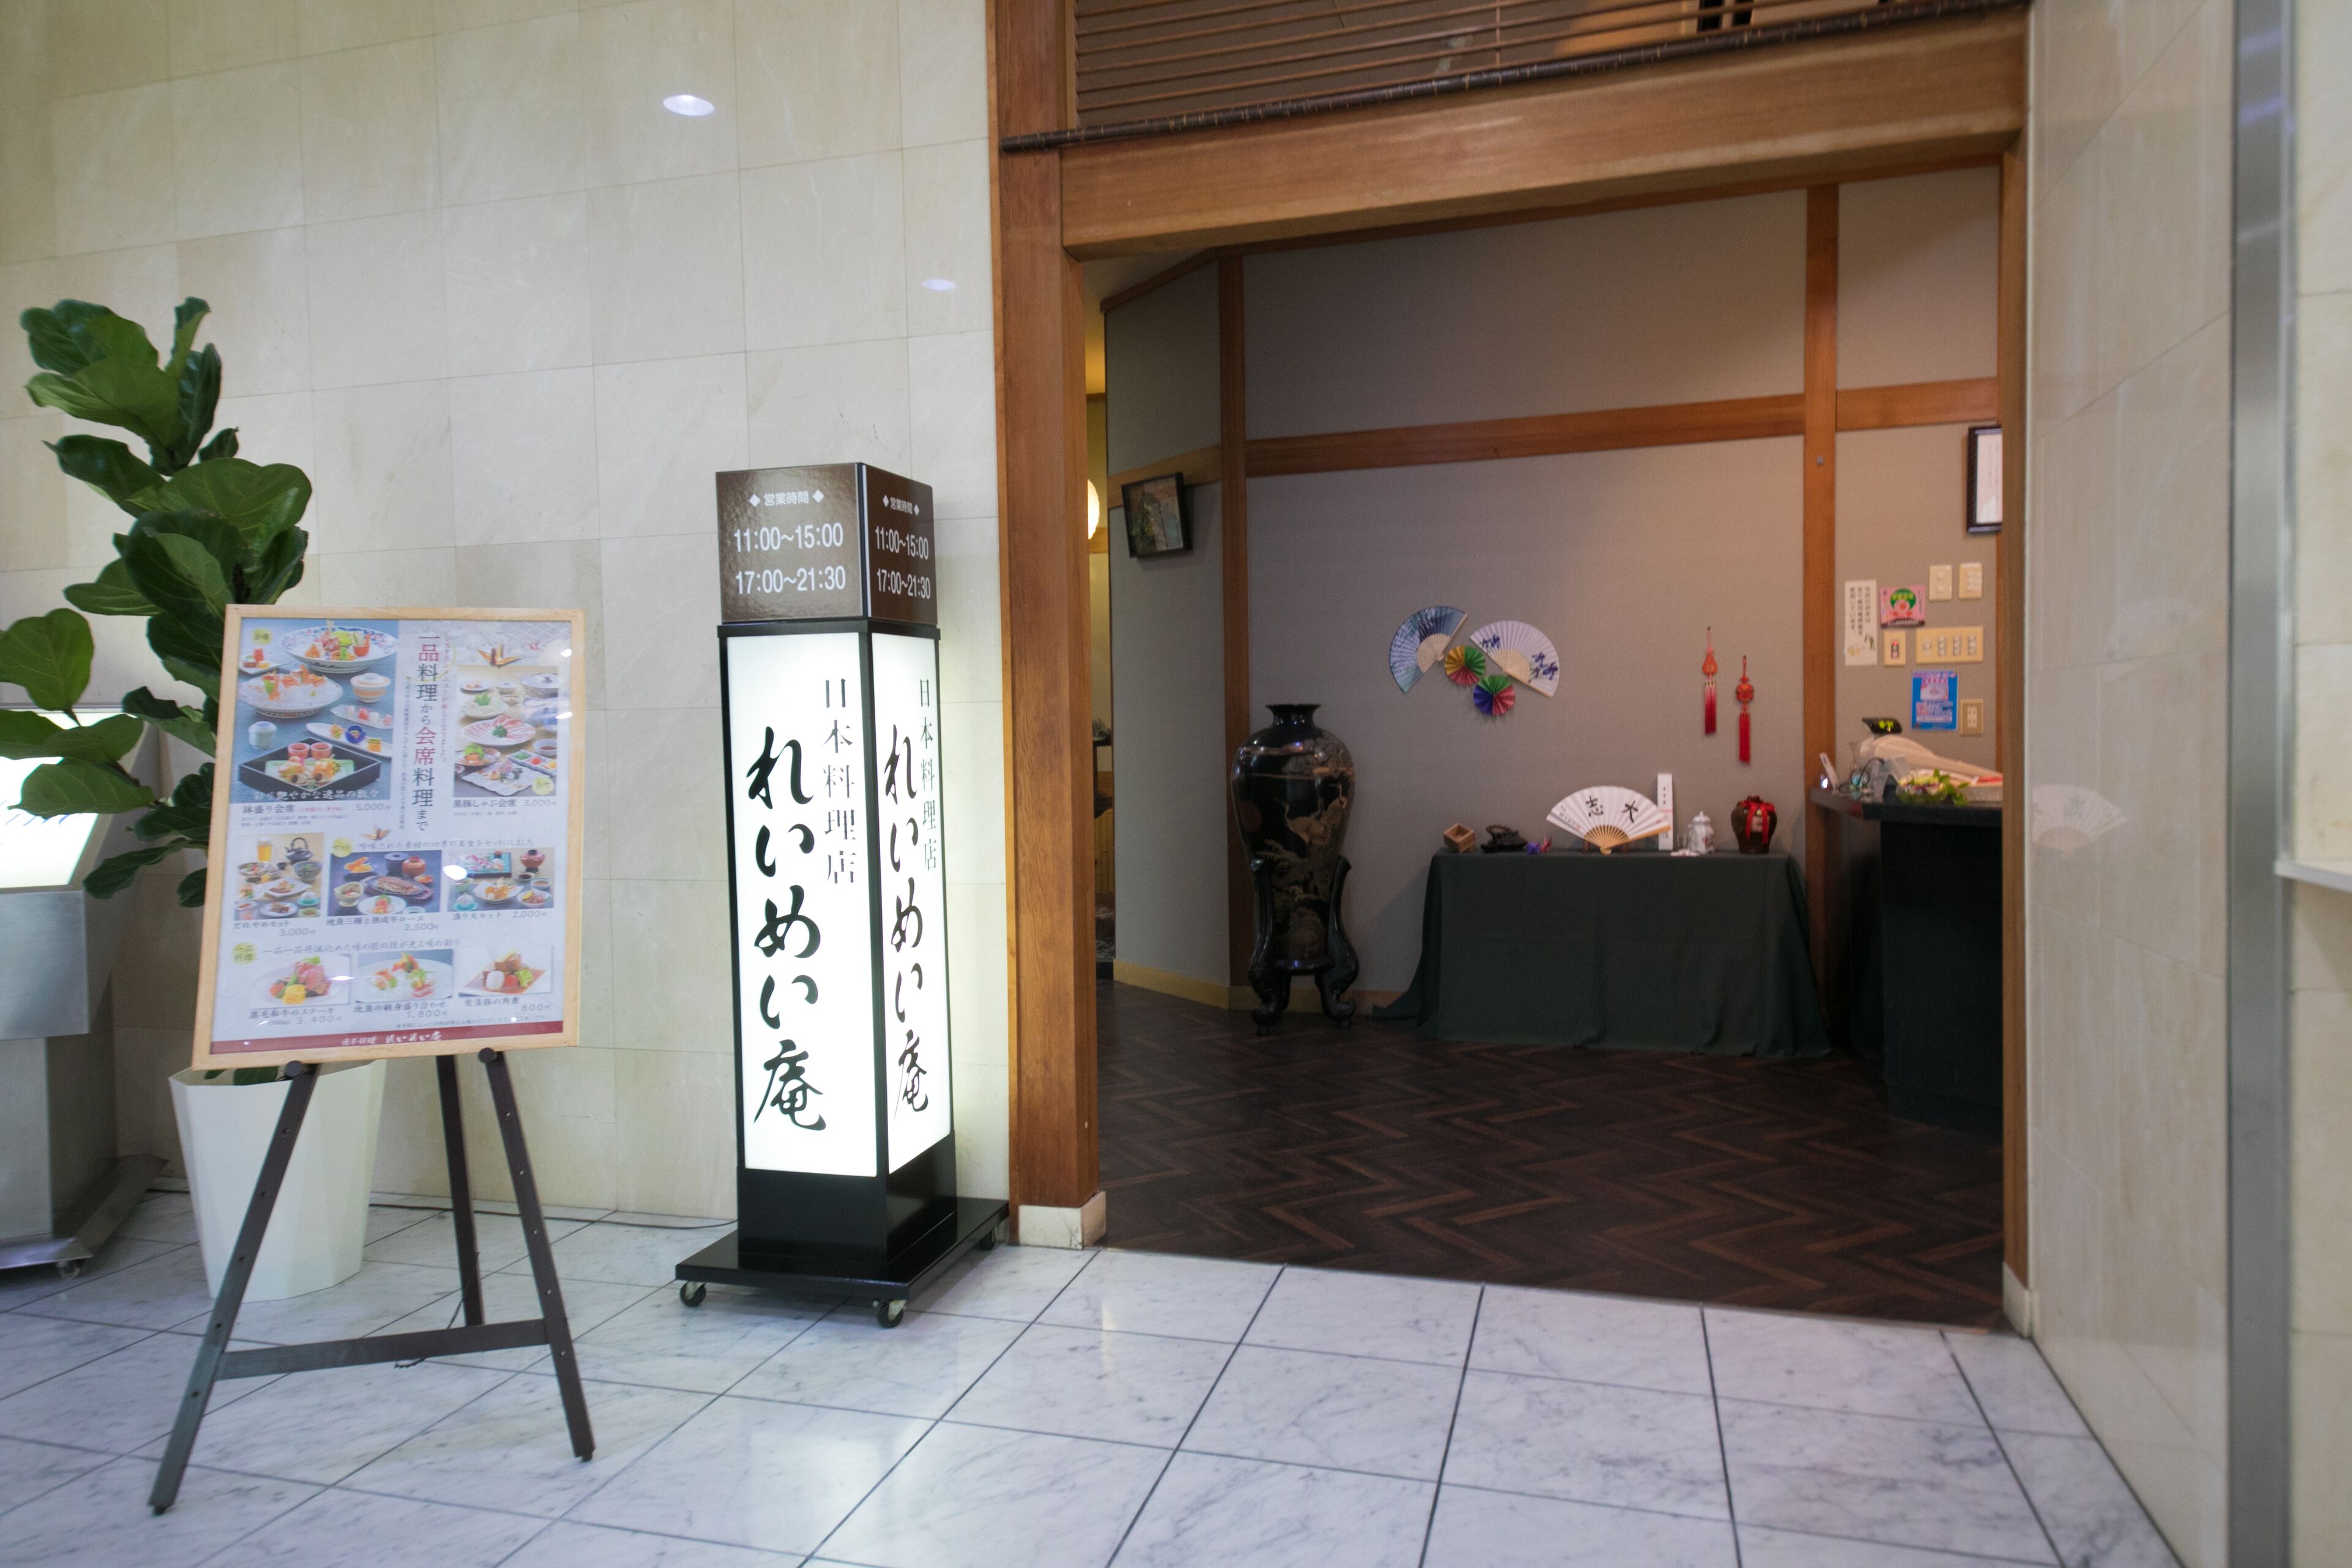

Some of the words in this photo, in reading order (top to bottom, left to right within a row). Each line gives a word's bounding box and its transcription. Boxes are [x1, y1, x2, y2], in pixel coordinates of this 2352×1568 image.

[764, 491, 809, 507] 営業時間
[890, 497, 913, 514] 営業時間
[412, 635, 441, 831] 一品料理から会席料理まで
[823, 677, 858, 885] 日本料理店
[918, 677, 938, 871] 日本料理店
[745, 725, 827, 1132] れいめい庵
[884, 723, 929, 1122] れいめい庵
